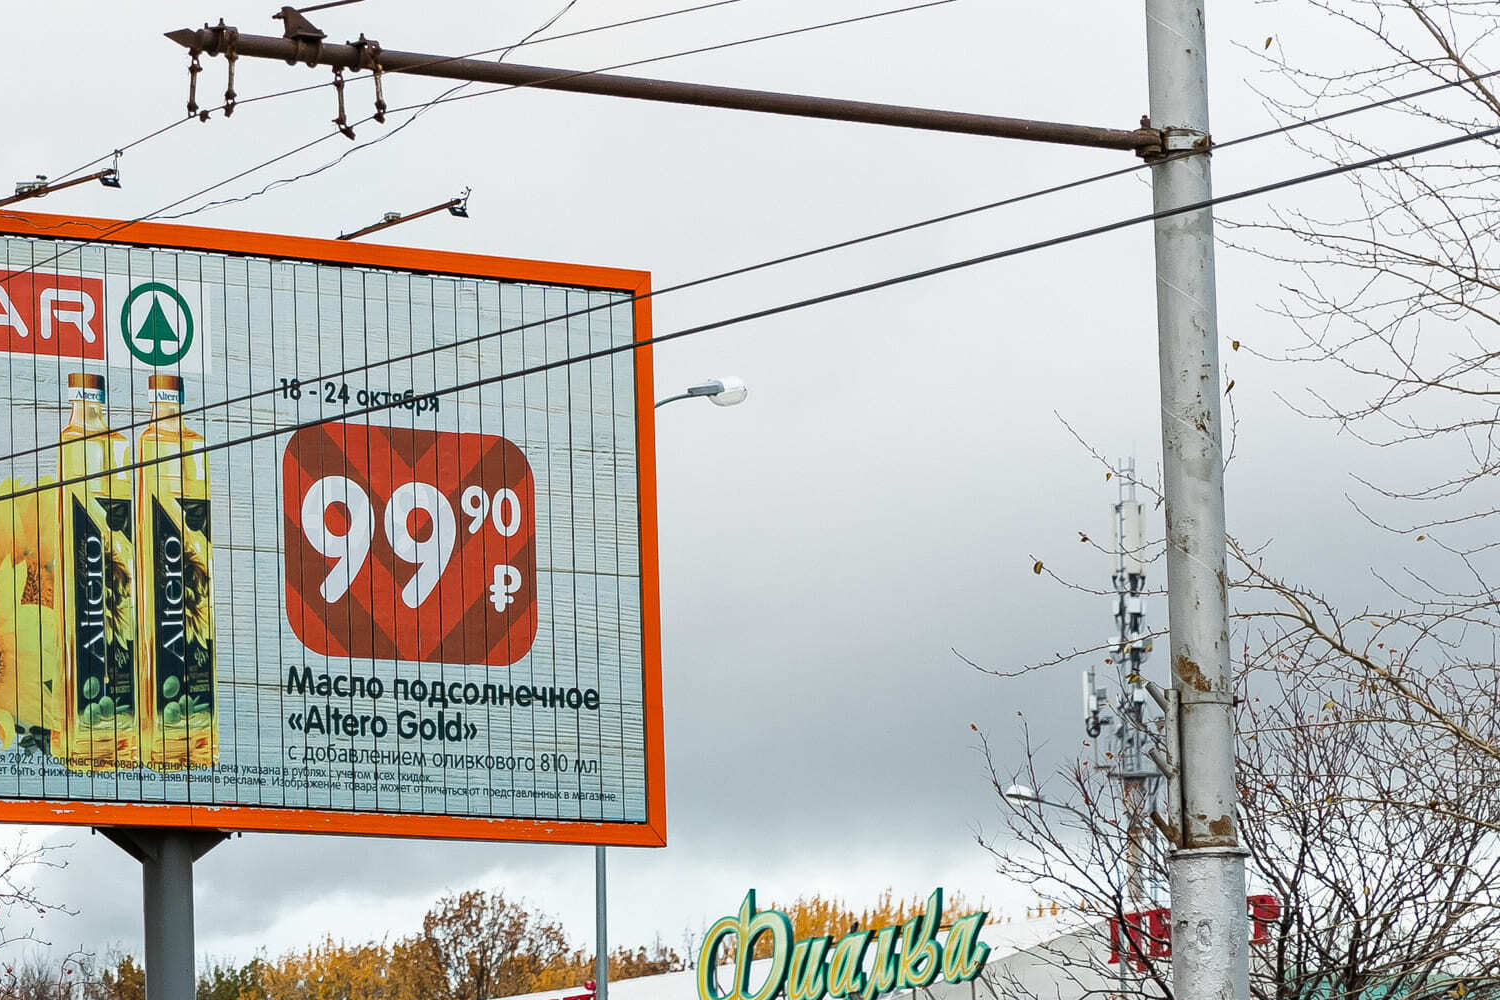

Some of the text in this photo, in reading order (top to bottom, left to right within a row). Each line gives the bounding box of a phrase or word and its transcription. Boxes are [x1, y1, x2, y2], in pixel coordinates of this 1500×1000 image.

[280, 379, 300, 400] 18
[324, 382, 349, 404] 24
[357, 389, 440, 416] октября
[302, 475, 521, 609] 99 90
[80, 536, 105, 663] Altero
[161, 536, 186, 663] Altero
[287, 665, 600, 710] Масло подсолнечное
[288, 704, 478, 742] «Altero Gold»
[8, 753, 35, 764] 2022
[45, 756, 106, 767] Количество
[214, 763, 239, 774] Цена
[242, 765, 281, 777] указана
[288, 744, 598, 774] с добавлением оливкового 810 мл
[11, 765, 35, 777] быть
[86, 770, 156, 782] относительно
[159, 773, 212, 784] заявления
[272, 776, 341, 790] Изображение
[344, 781, 378, 791] товара
[380, 784, 411, 793] может
[483, 788, 562, 800] представленных
